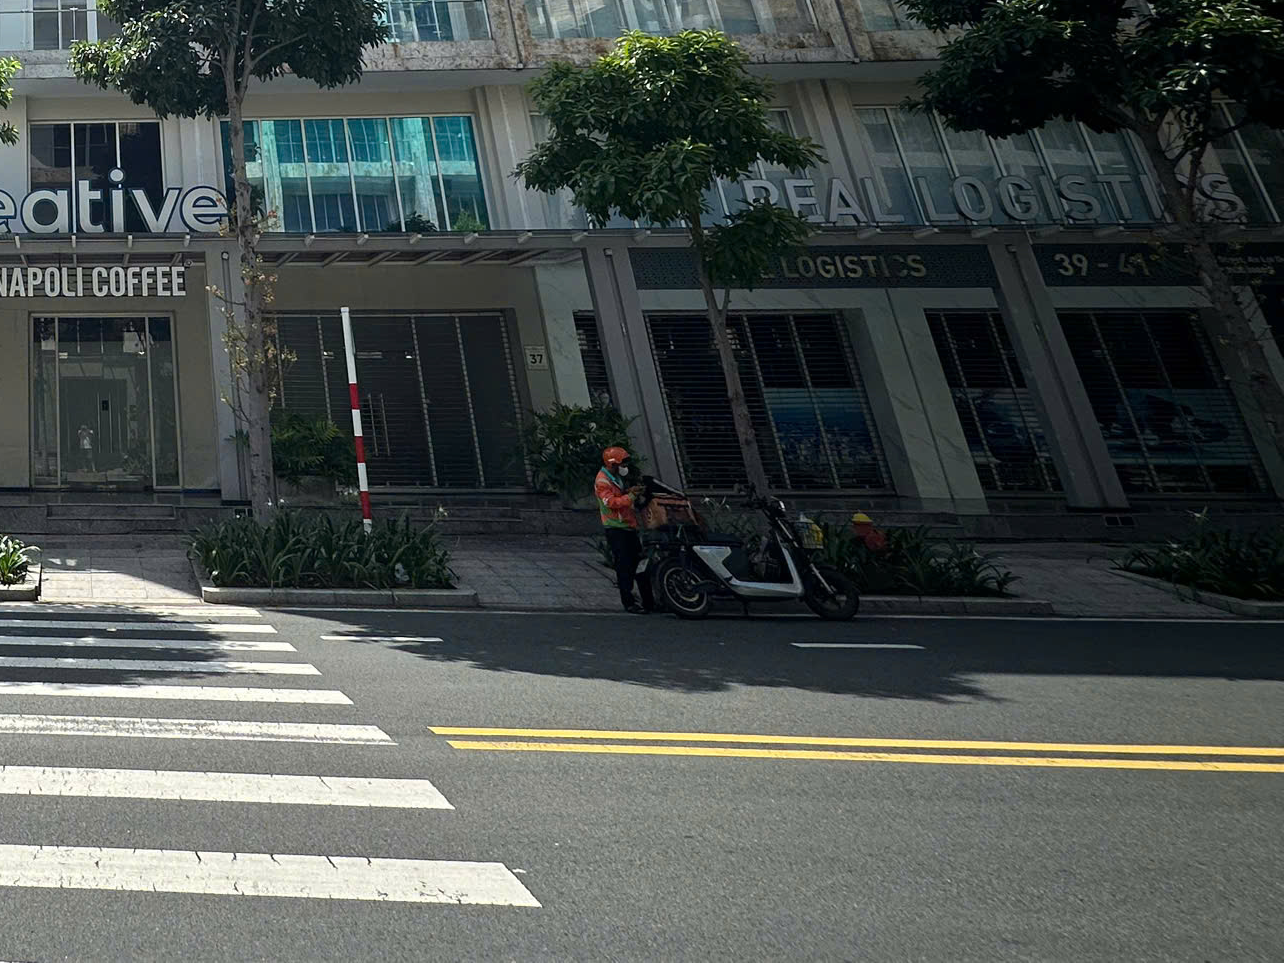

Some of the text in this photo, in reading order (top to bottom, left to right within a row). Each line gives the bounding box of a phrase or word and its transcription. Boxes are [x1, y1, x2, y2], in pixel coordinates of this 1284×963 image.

[916, 174, 1248, 223] LOGISTIS
[1052, 252, 1089, 277] 39
[92, 265, 187, 297] COFFEE
[529, 353, 543, 364] 37
